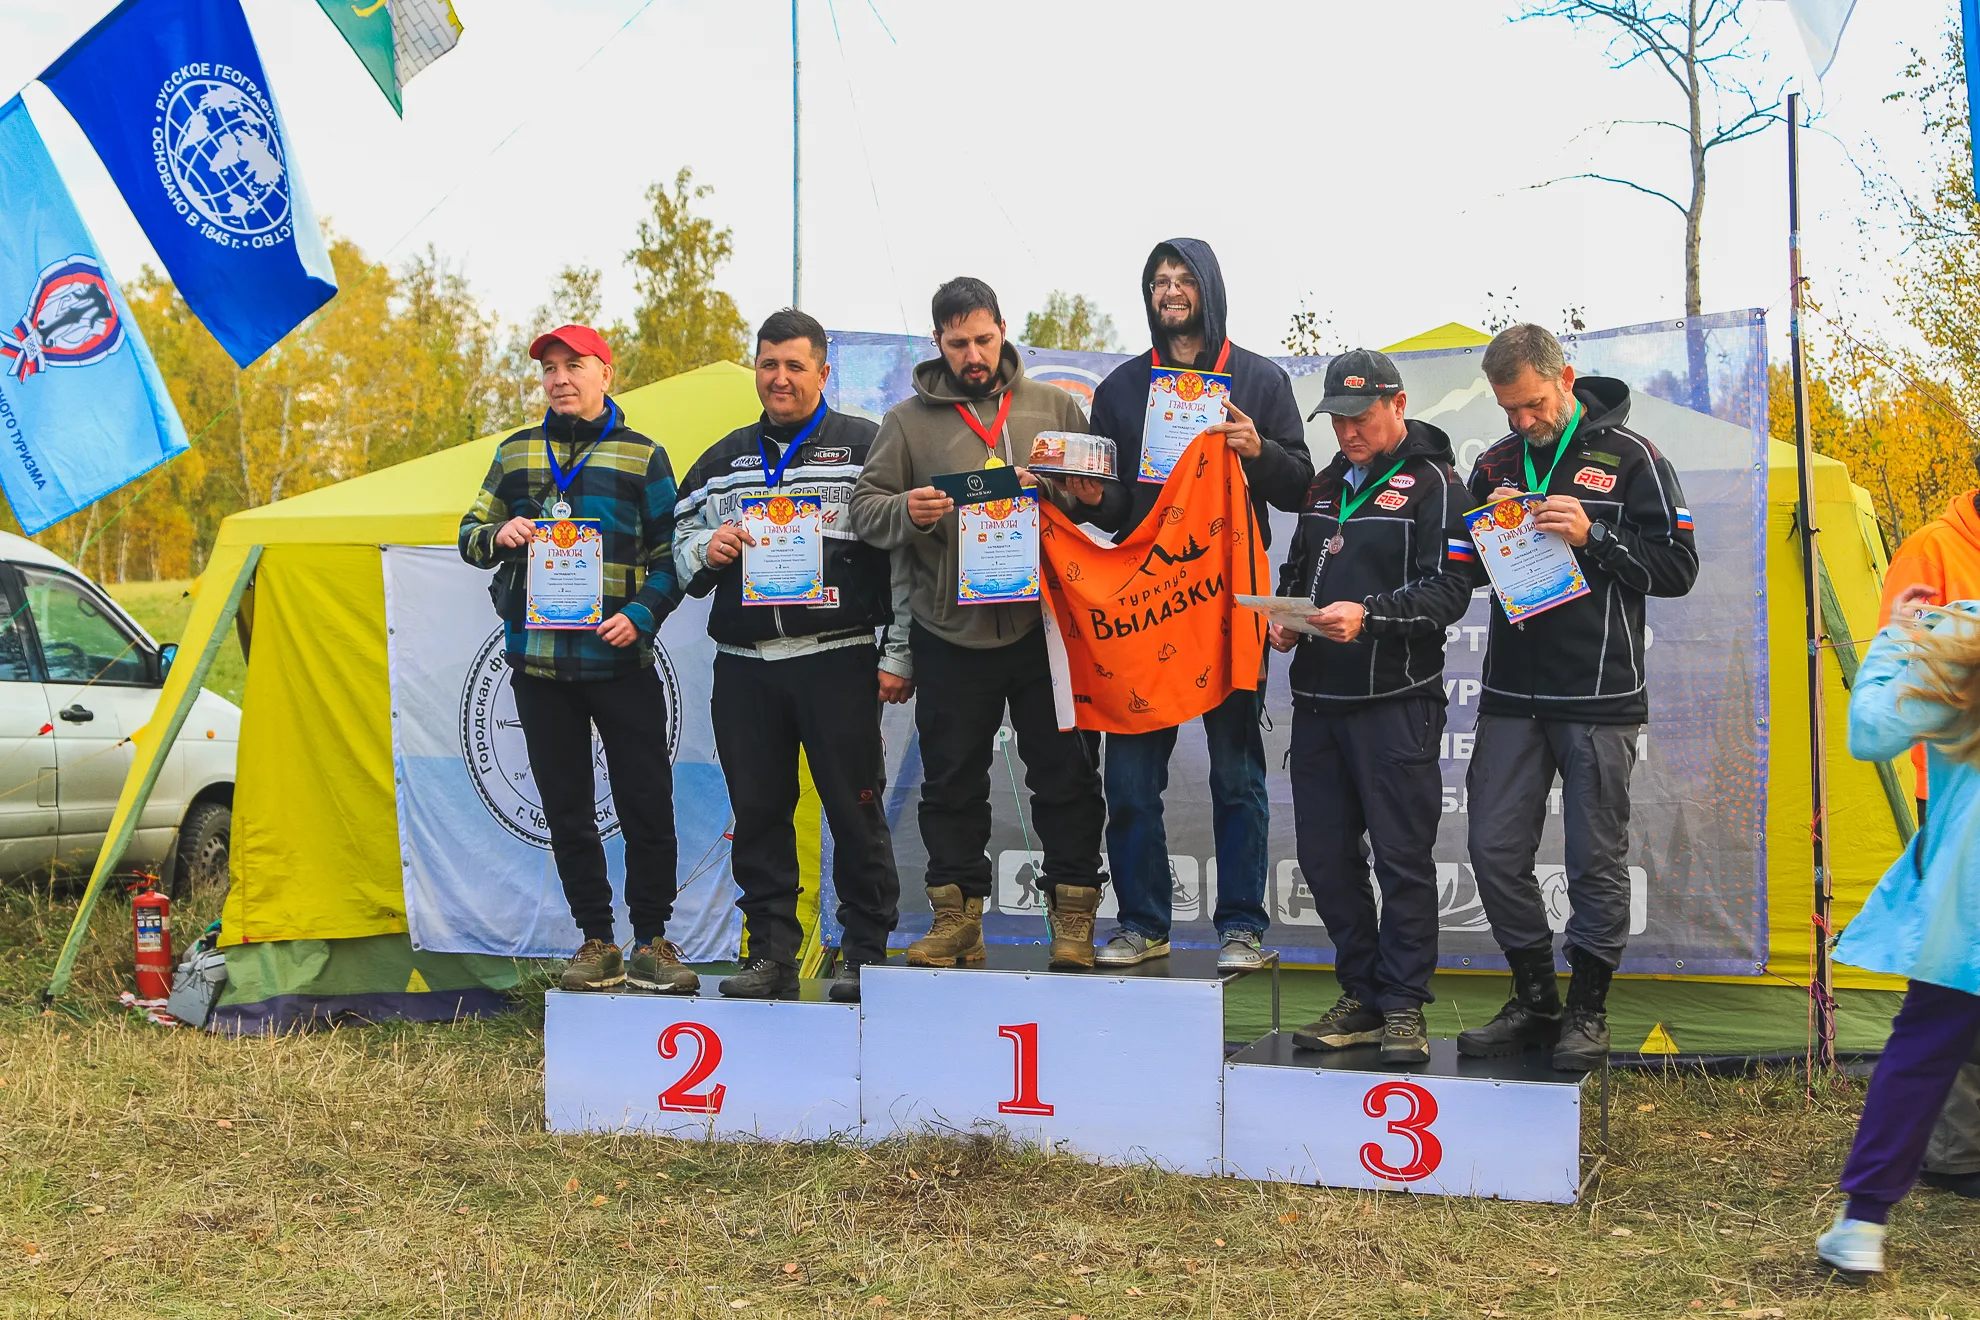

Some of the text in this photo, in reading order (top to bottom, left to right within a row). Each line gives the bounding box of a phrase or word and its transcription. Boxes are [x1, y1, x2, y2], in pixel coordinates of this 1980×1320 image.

[152, 127, 189, 215] ОСНОВАНО
[185, 214, 201, 227] В
[200, 223, 231, 246] 1845
[155, 63, 210, 111] РУССКОЕ
[251, 217, 292, 249] СТВО
[10, 428, 47, 491] ТУРИЗМА
[1376, 494, 1406, 506] RED
[1390, 477, 1414, 485] SINTEC
[1577, 471, 1614, 488] RED
[474, 676, 492, 774] Городская
[657, 1021, 727, 1115] 2
[998, 1022, 1055, 1117] 1
[1359, 1081, 1443, 1182] 3
